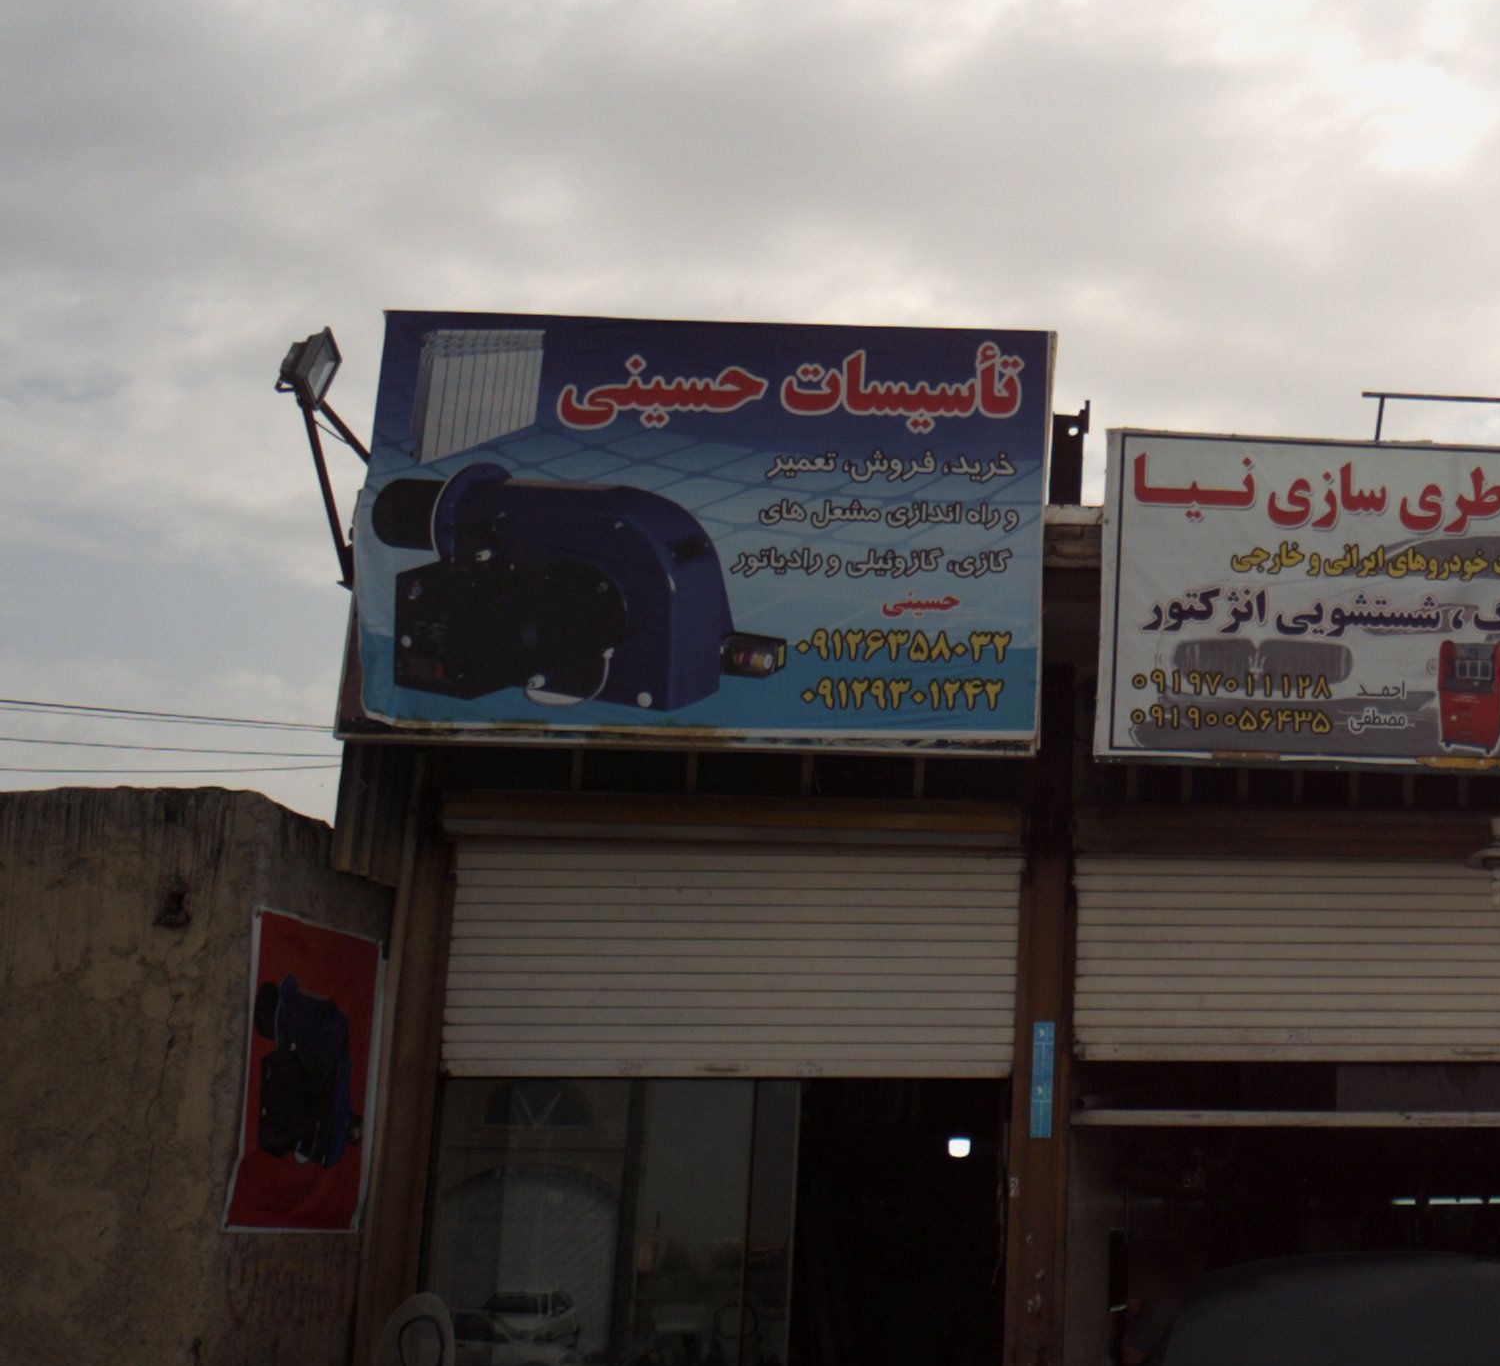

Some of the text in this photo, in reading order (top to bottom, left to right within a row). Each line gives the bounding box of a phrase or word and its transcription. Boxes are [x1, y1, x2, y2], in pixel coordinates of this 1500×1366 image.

[557, 341, 1025, 435] تأسیسات حسینی
[766, 451, 837, 478] تعمیر
[1267, 461, 1387, 529] سازی
[759, 499, 1019, 531] و راه اندازی مشعل های
[730, 547, 823, 576] رادیاتور
[826, 554, 842, 575] و
[1231, 540, 1305, 575] خارجی
[1306, 552, 1322, 576] و
[1323, 543, 1385, 578] ایرانی
[882, 592, 960, 617] حسینی
[1275, 593, 1441, 636] شستشویی
[796, 627, 1012, 663] ۰۹۱۲۶۳۵۸۰۳۲
[802, 677, 1004, 711] ۰۹۱۲۹۳۰۱۲۴۲
[1132, 669, 1407, 700] احمد ۰۹۱۹۷۰۱۱۱۲۸
[1130, 704, 1408, 734] مصطفی ۰۹۱۹۰۰۵۶۴۳۵
